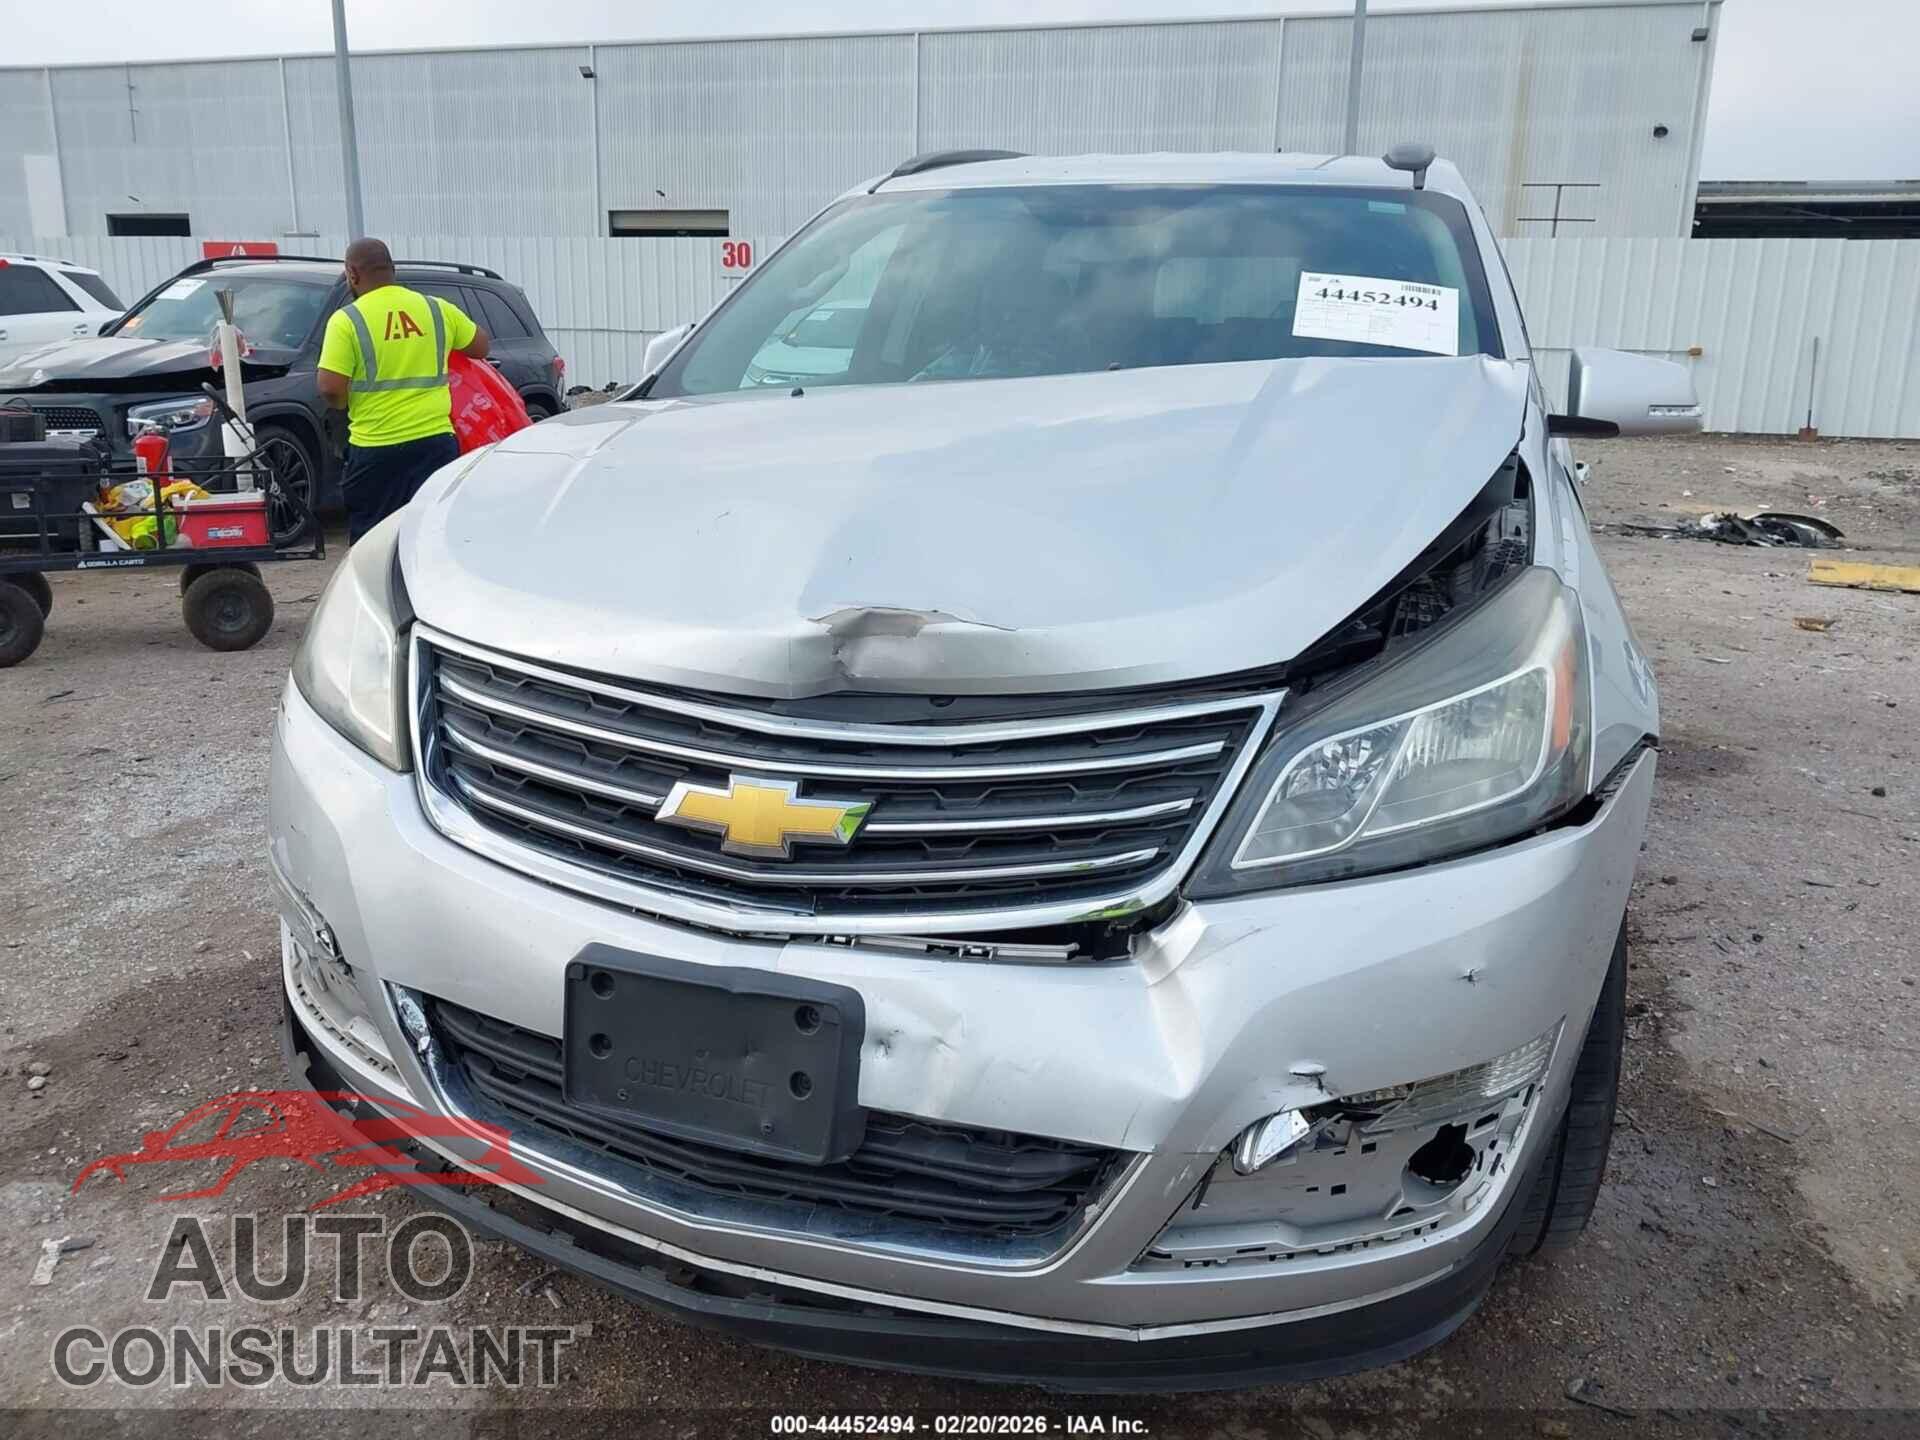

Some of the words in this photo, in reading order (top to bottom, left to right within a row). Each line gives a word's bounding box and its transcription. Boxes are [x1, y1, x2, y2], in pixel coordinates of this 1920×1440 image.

[722, 241, 751, 269] 30
[1314, 287, 1438, 311] 44452494
[624, 1055, 776, 1108] CHEVROLET
